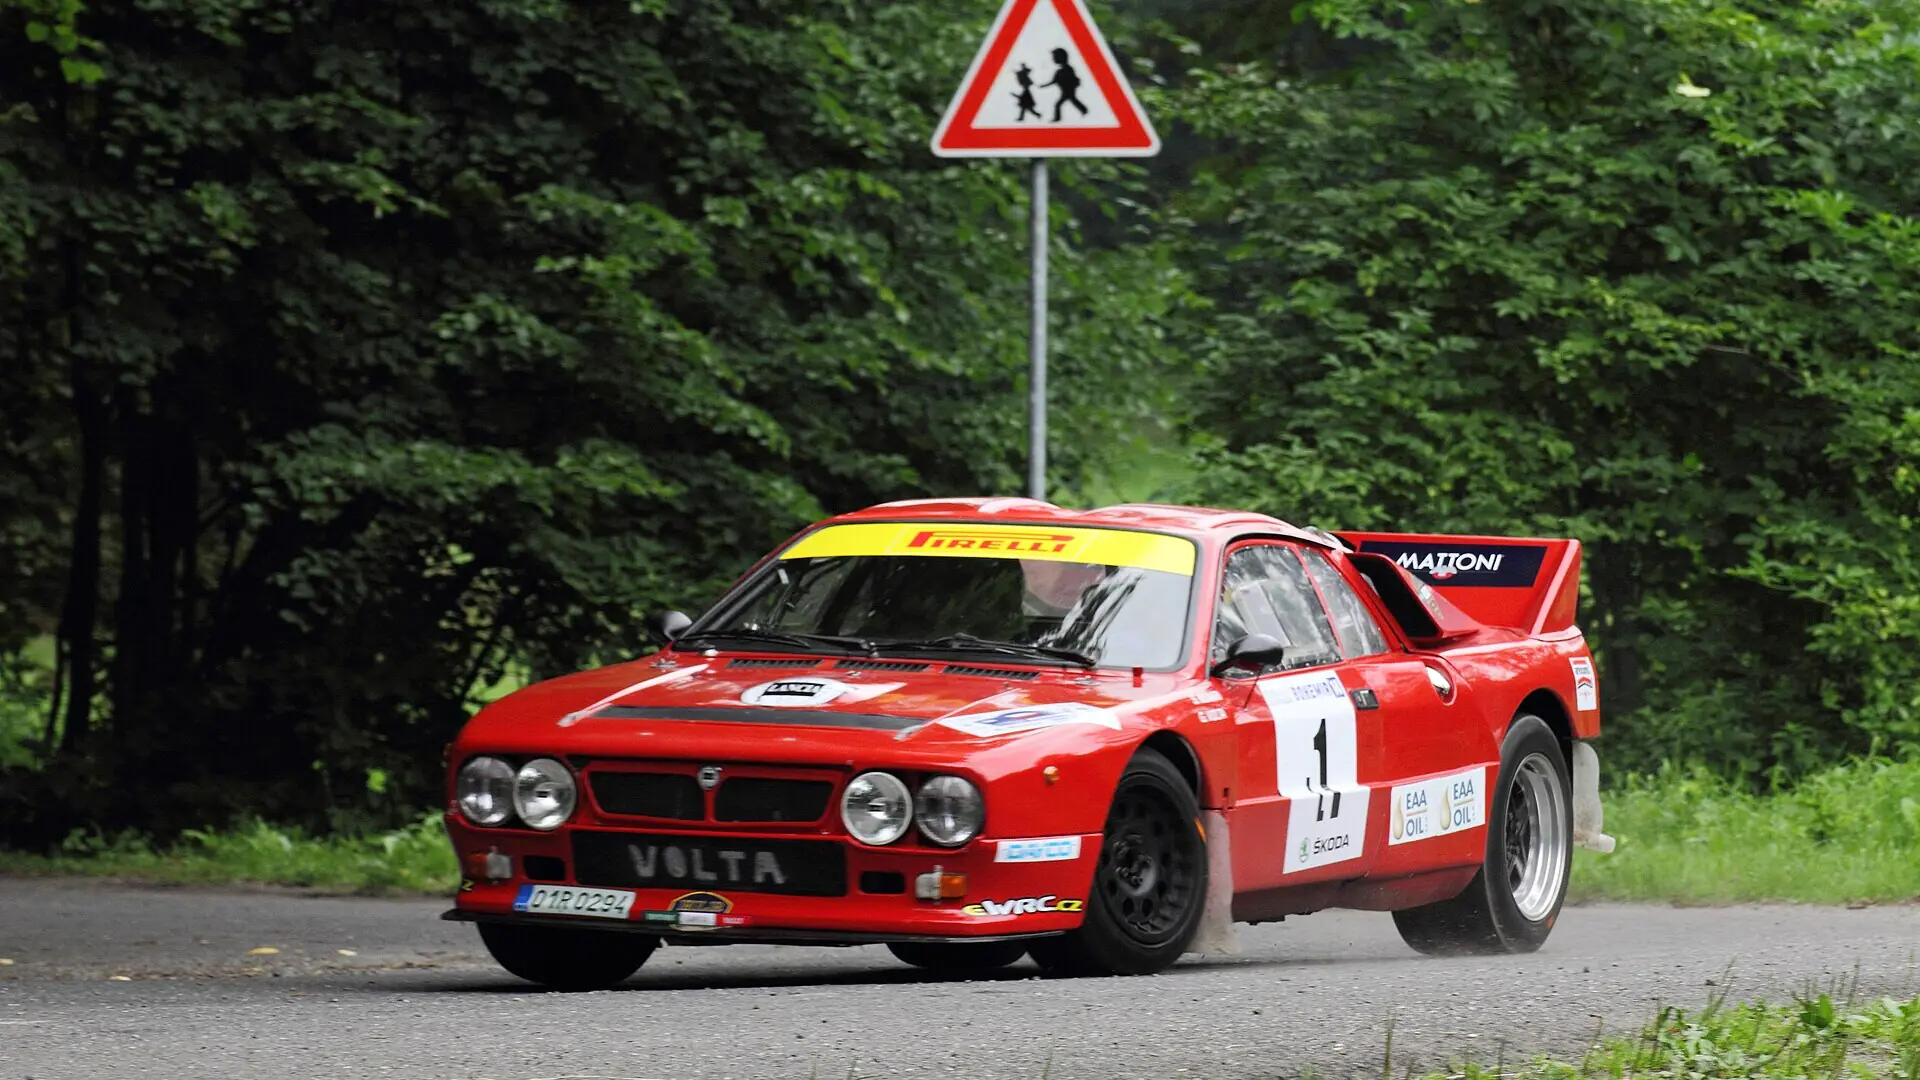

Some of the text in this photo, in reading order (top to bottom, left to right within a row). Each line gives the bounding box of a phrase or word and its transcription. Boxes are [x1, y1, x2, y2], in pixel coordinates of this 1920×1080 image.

[907, 531, 1075, 552] PIRELLI
[1396, 552, 1502, 571] MATTONI
[1406, 789, 1428, 810] EAA
[1453, 779, 1475, 800] EAA
[1405, 816, 1424, 837] OIL
[1453, 806, 1471, 827] OIL
[1313, 834, 1350, 855] ŠKODA
[627, 844, 789, 884] VOLTA
